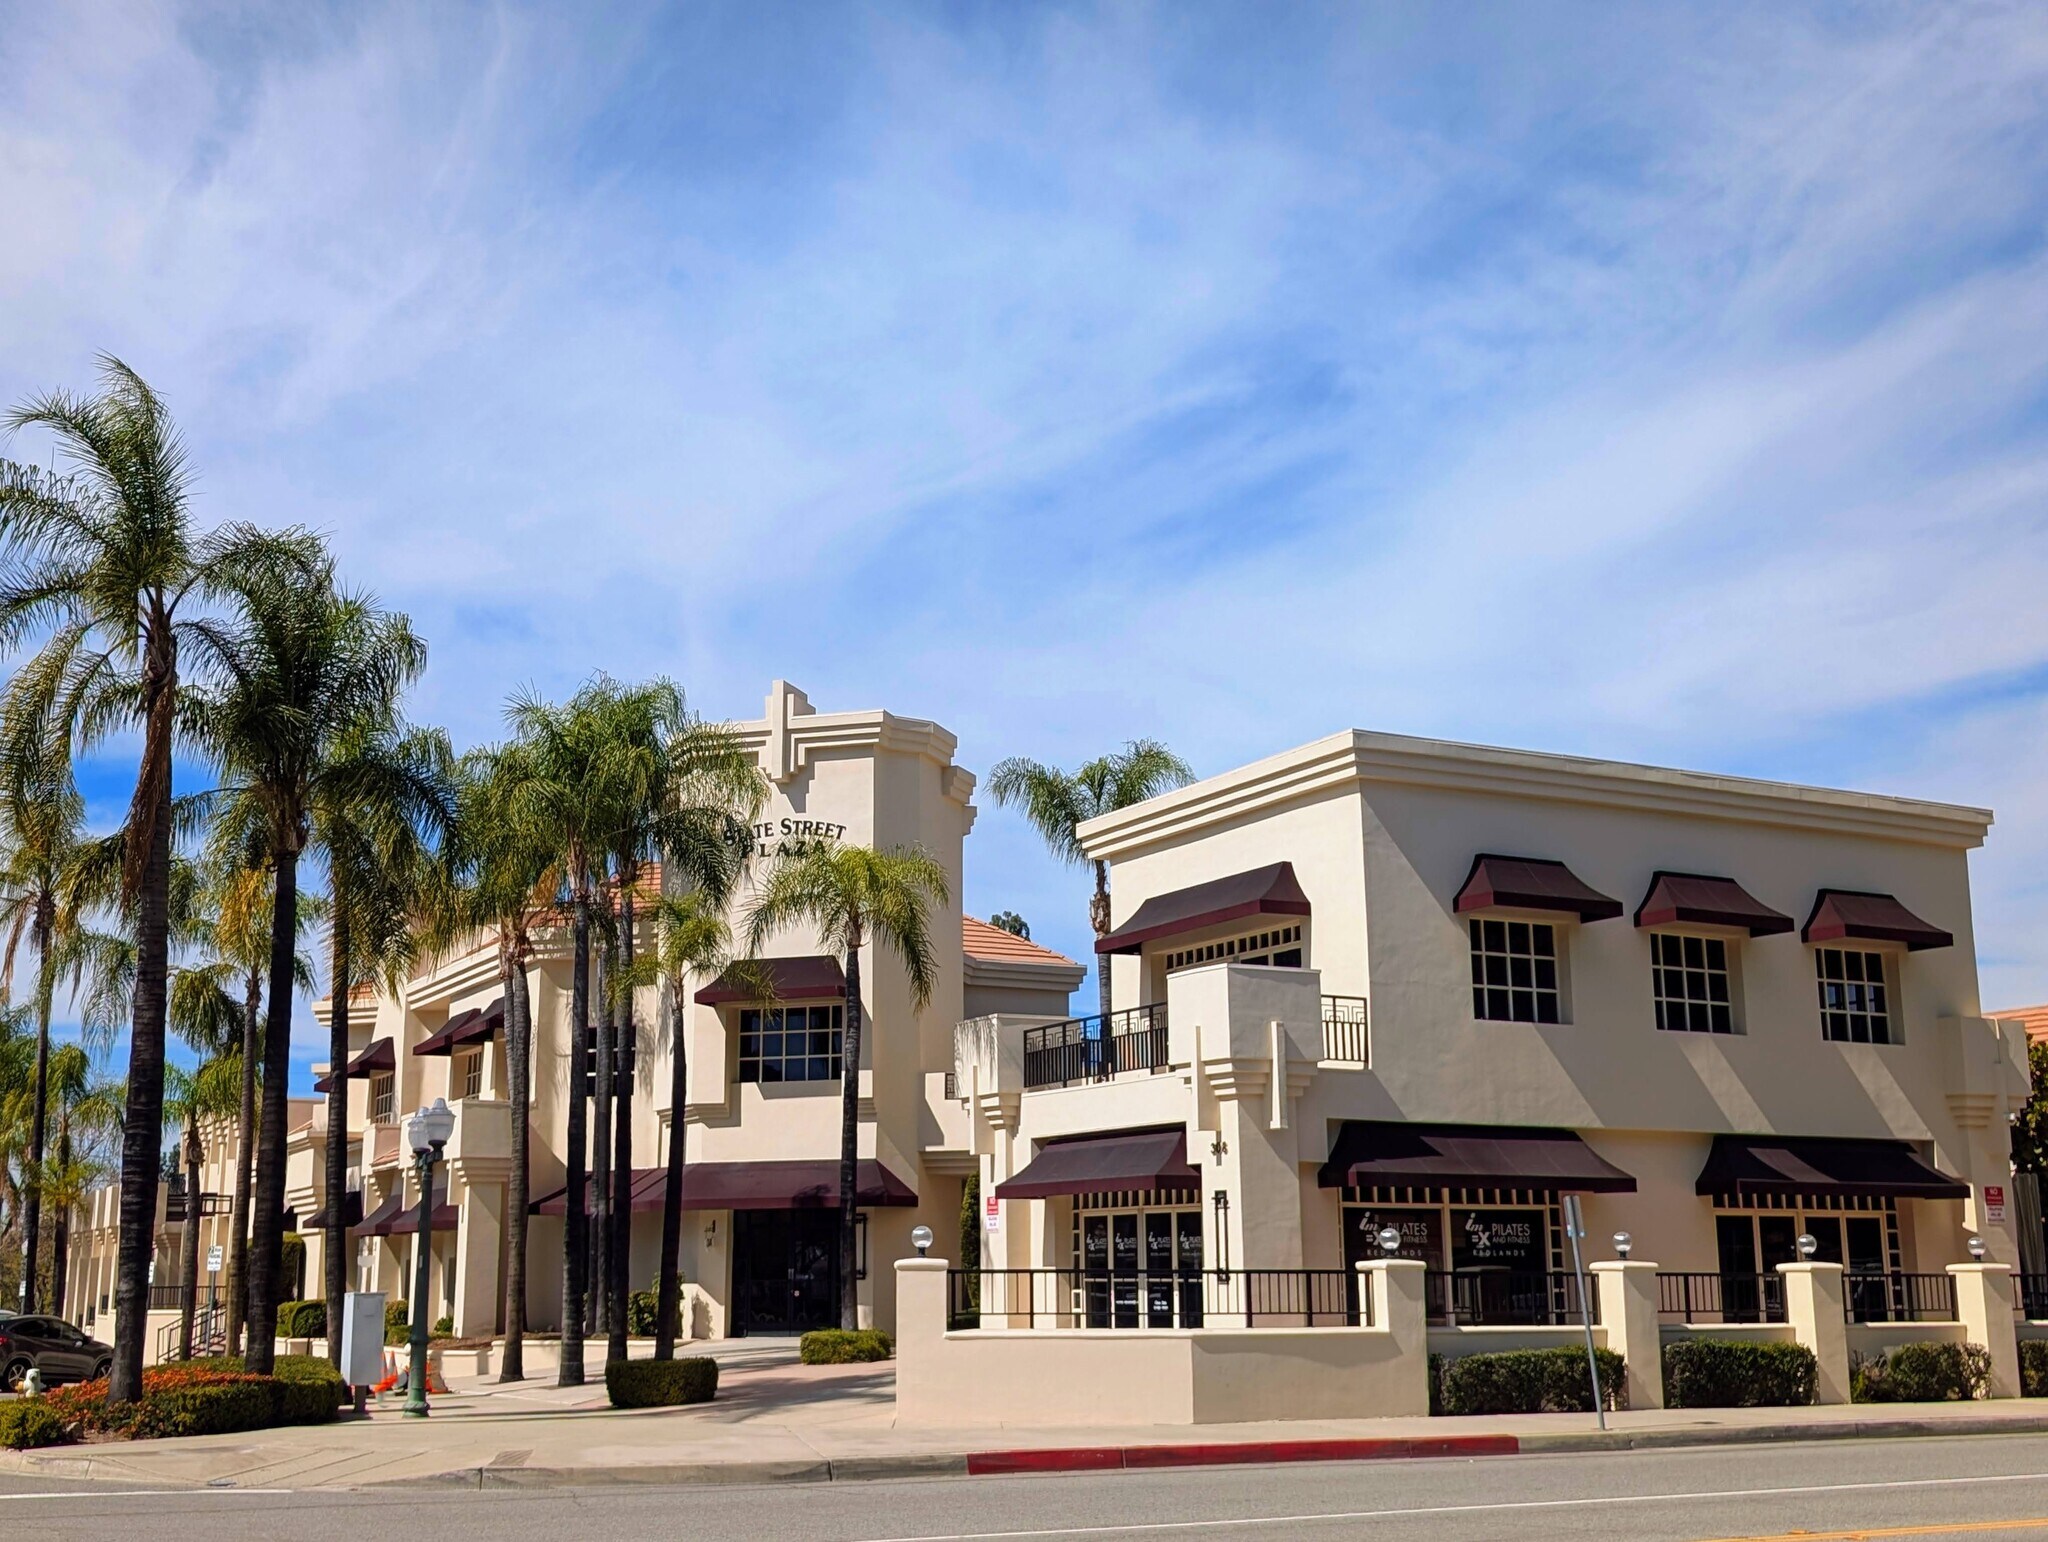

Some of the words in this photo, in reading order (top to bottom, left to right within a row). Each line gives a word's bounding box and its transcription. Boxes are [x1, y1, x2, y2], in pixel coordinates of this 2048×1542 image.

[780, 817, 847, 840] STREET
[740, 839, 827, 859] PLAZA
[1491, 1223, 1531, 1236] PILATES
[1366, 1249, 1422, 1257] REDANDS
[1472, 1249, 1526, 1257] REDLANDS
